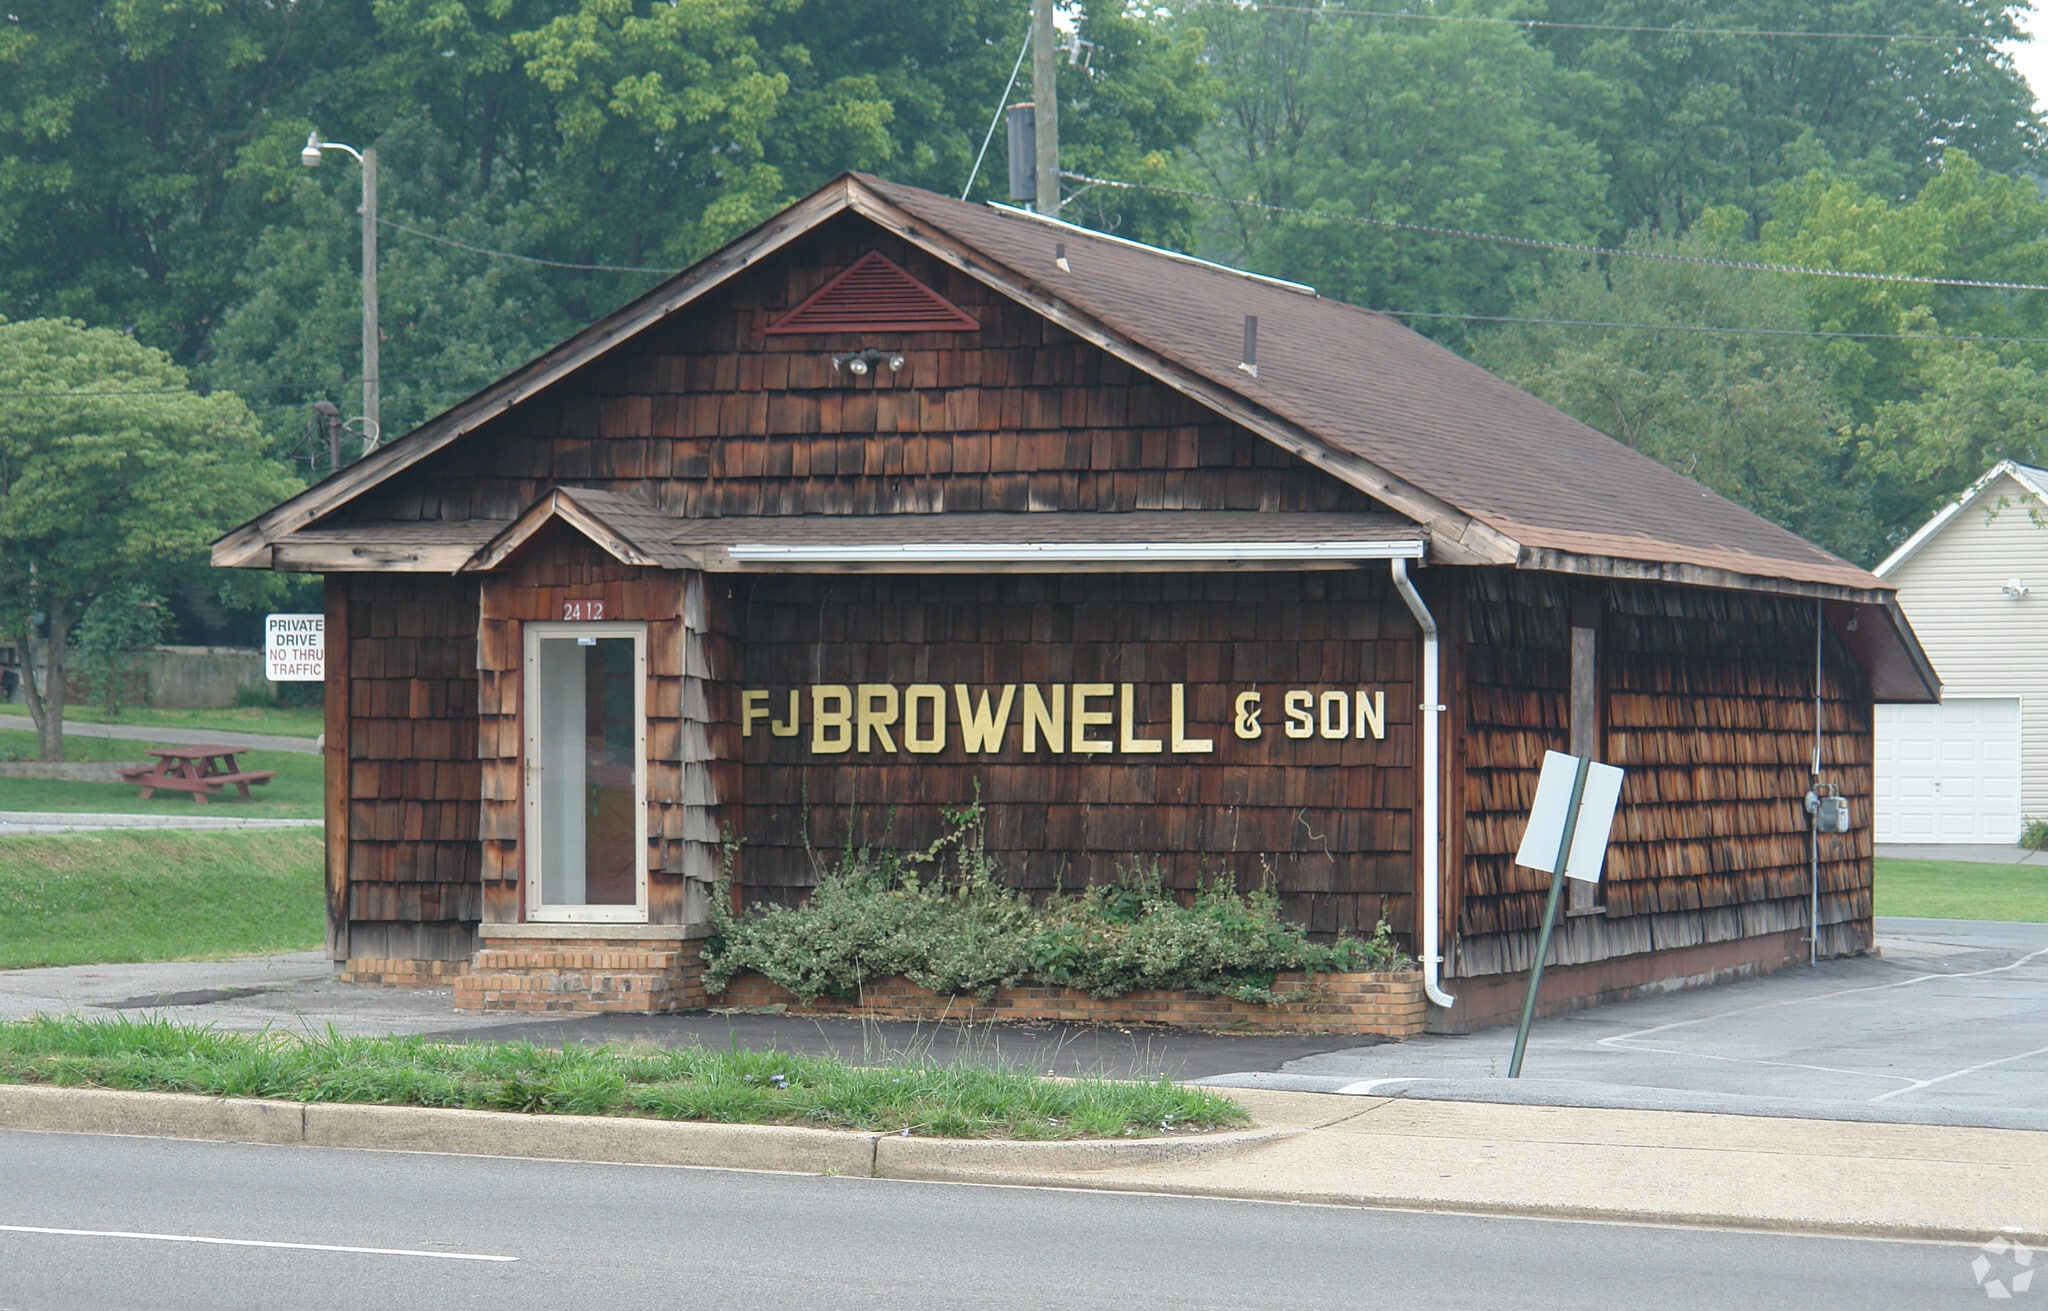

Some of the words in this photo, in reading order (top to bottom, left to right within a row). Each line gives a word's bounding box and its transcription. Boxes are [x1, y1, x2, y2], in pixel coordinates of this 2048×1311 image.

[269, 619, 324, 632] PRIVATE
[276, 634, 317, 647] DRIVE
[269, 648, 287, 661] NO
[292, 648, 324, 661] THRU
[272, 663, 322, 676] TRAFFIC
[742, 689, 800, 737] FJ
[811, 683, 1214, 754] BROWNELL
[1234, 690, 1262, 740] &
[1284, 690, 1385, 740] SON
